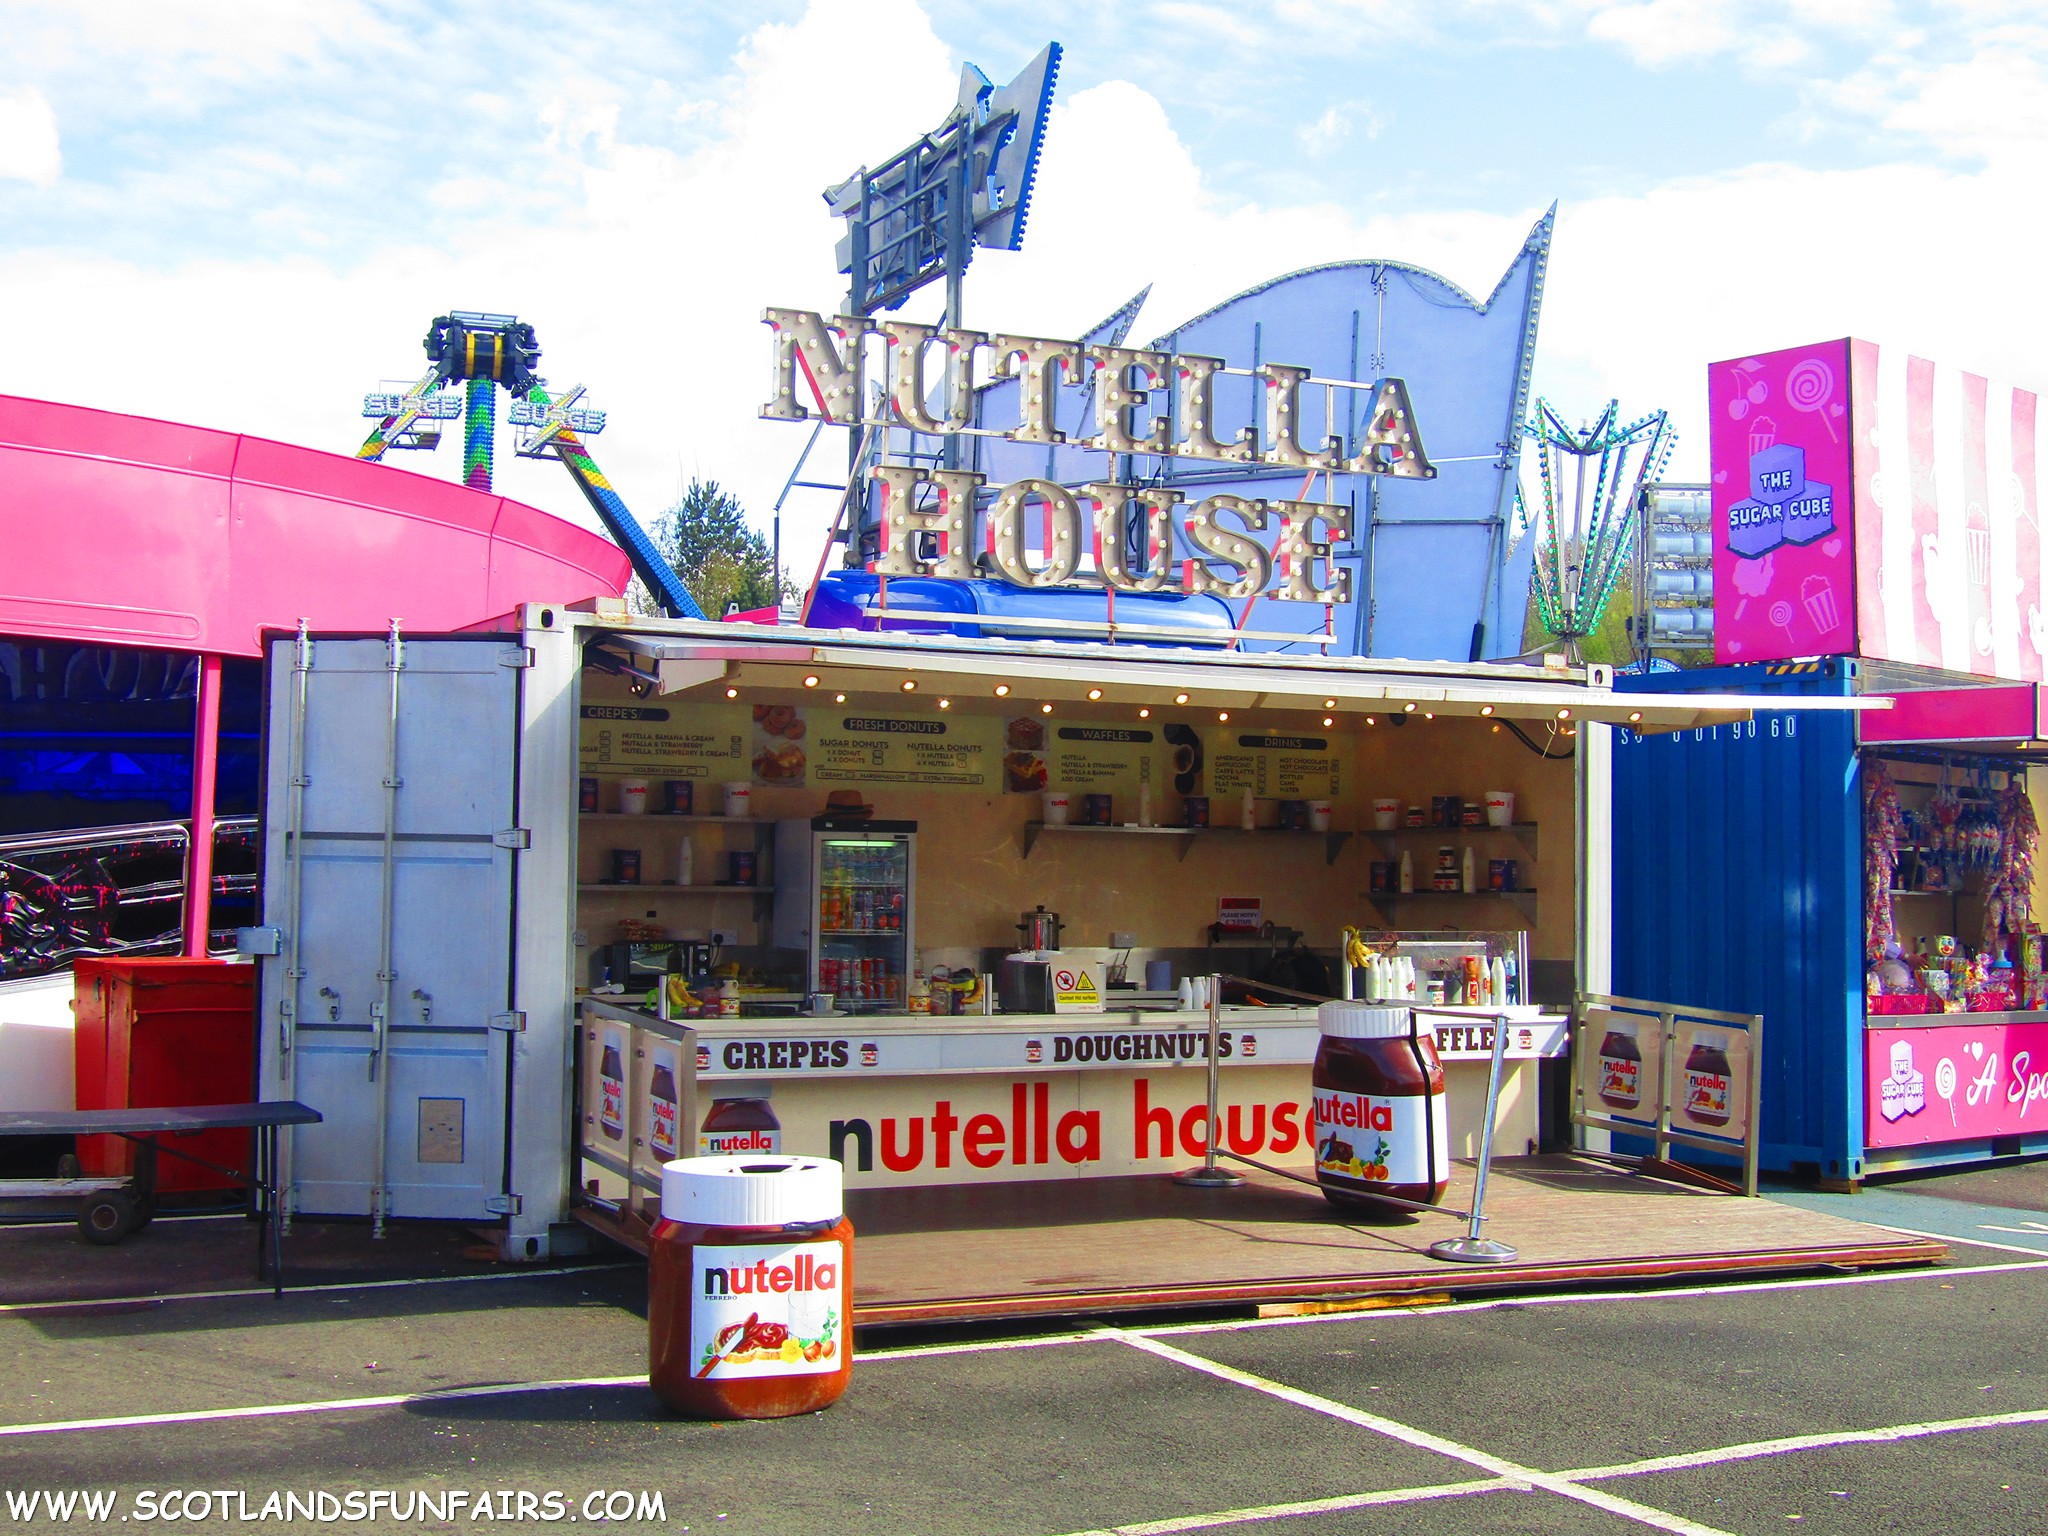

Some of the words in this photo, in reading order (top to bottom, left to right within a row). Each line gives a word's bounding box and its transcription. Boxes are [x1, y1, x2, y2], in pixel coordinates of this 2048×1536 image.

[758, 307, 1438, 480] NUTELLA
[361, 392, 463, 419] SURGE
[508, 400, 607, 434] SURGE
[1760, 470, 1791, 491] THE
[1729, 504, 1782, 526] SUGAR
[1789, 497, 1831, 517] CUBE
[867, 465, 1352, 603] HOUSE
[588, 707, 638, 720] CREPE'S
[849, 719, 886, 731] FRESH
[890, 721, 940, 733] DONUTS
[1082, 729, 1130, 740] WAFFLES
[660, 741, 704, 749] STRAWBERRY
[819, 739, 849, 747] SUGAR
[852, 740, 889, 749] DONUTS
[907, 743, 944, 751] NUTELLA
[947, 744, 982, 753] DONUTS
[1264, 738, 1302, 748] DRINKS
[723, 1040, 849, 1070] CREPES
[1053, 1032, 1233, 1062] DOUGHNUTS
[1604, 1059, 1637, 1076] nutella
[1894, 1059, 1908, 1072] THE
[602, 1079, 621, 1099] nutella
[1689, 1073, 1726, 1091] nutella
[1966, 1052, 1998, 1106] A
[1881, 1085, 1905, 1098] SUGAR
[1906, 1082, 1924, 1095] CUBE
[653, 1101, 675, 1122] nutella
[1313, 1093, 1393, 1131] nutella
[829, 1082, 1101, 1172] nutella
[710, 1130, 772, 1151] nutella
[705, 1254, 836, 1294] nutella
